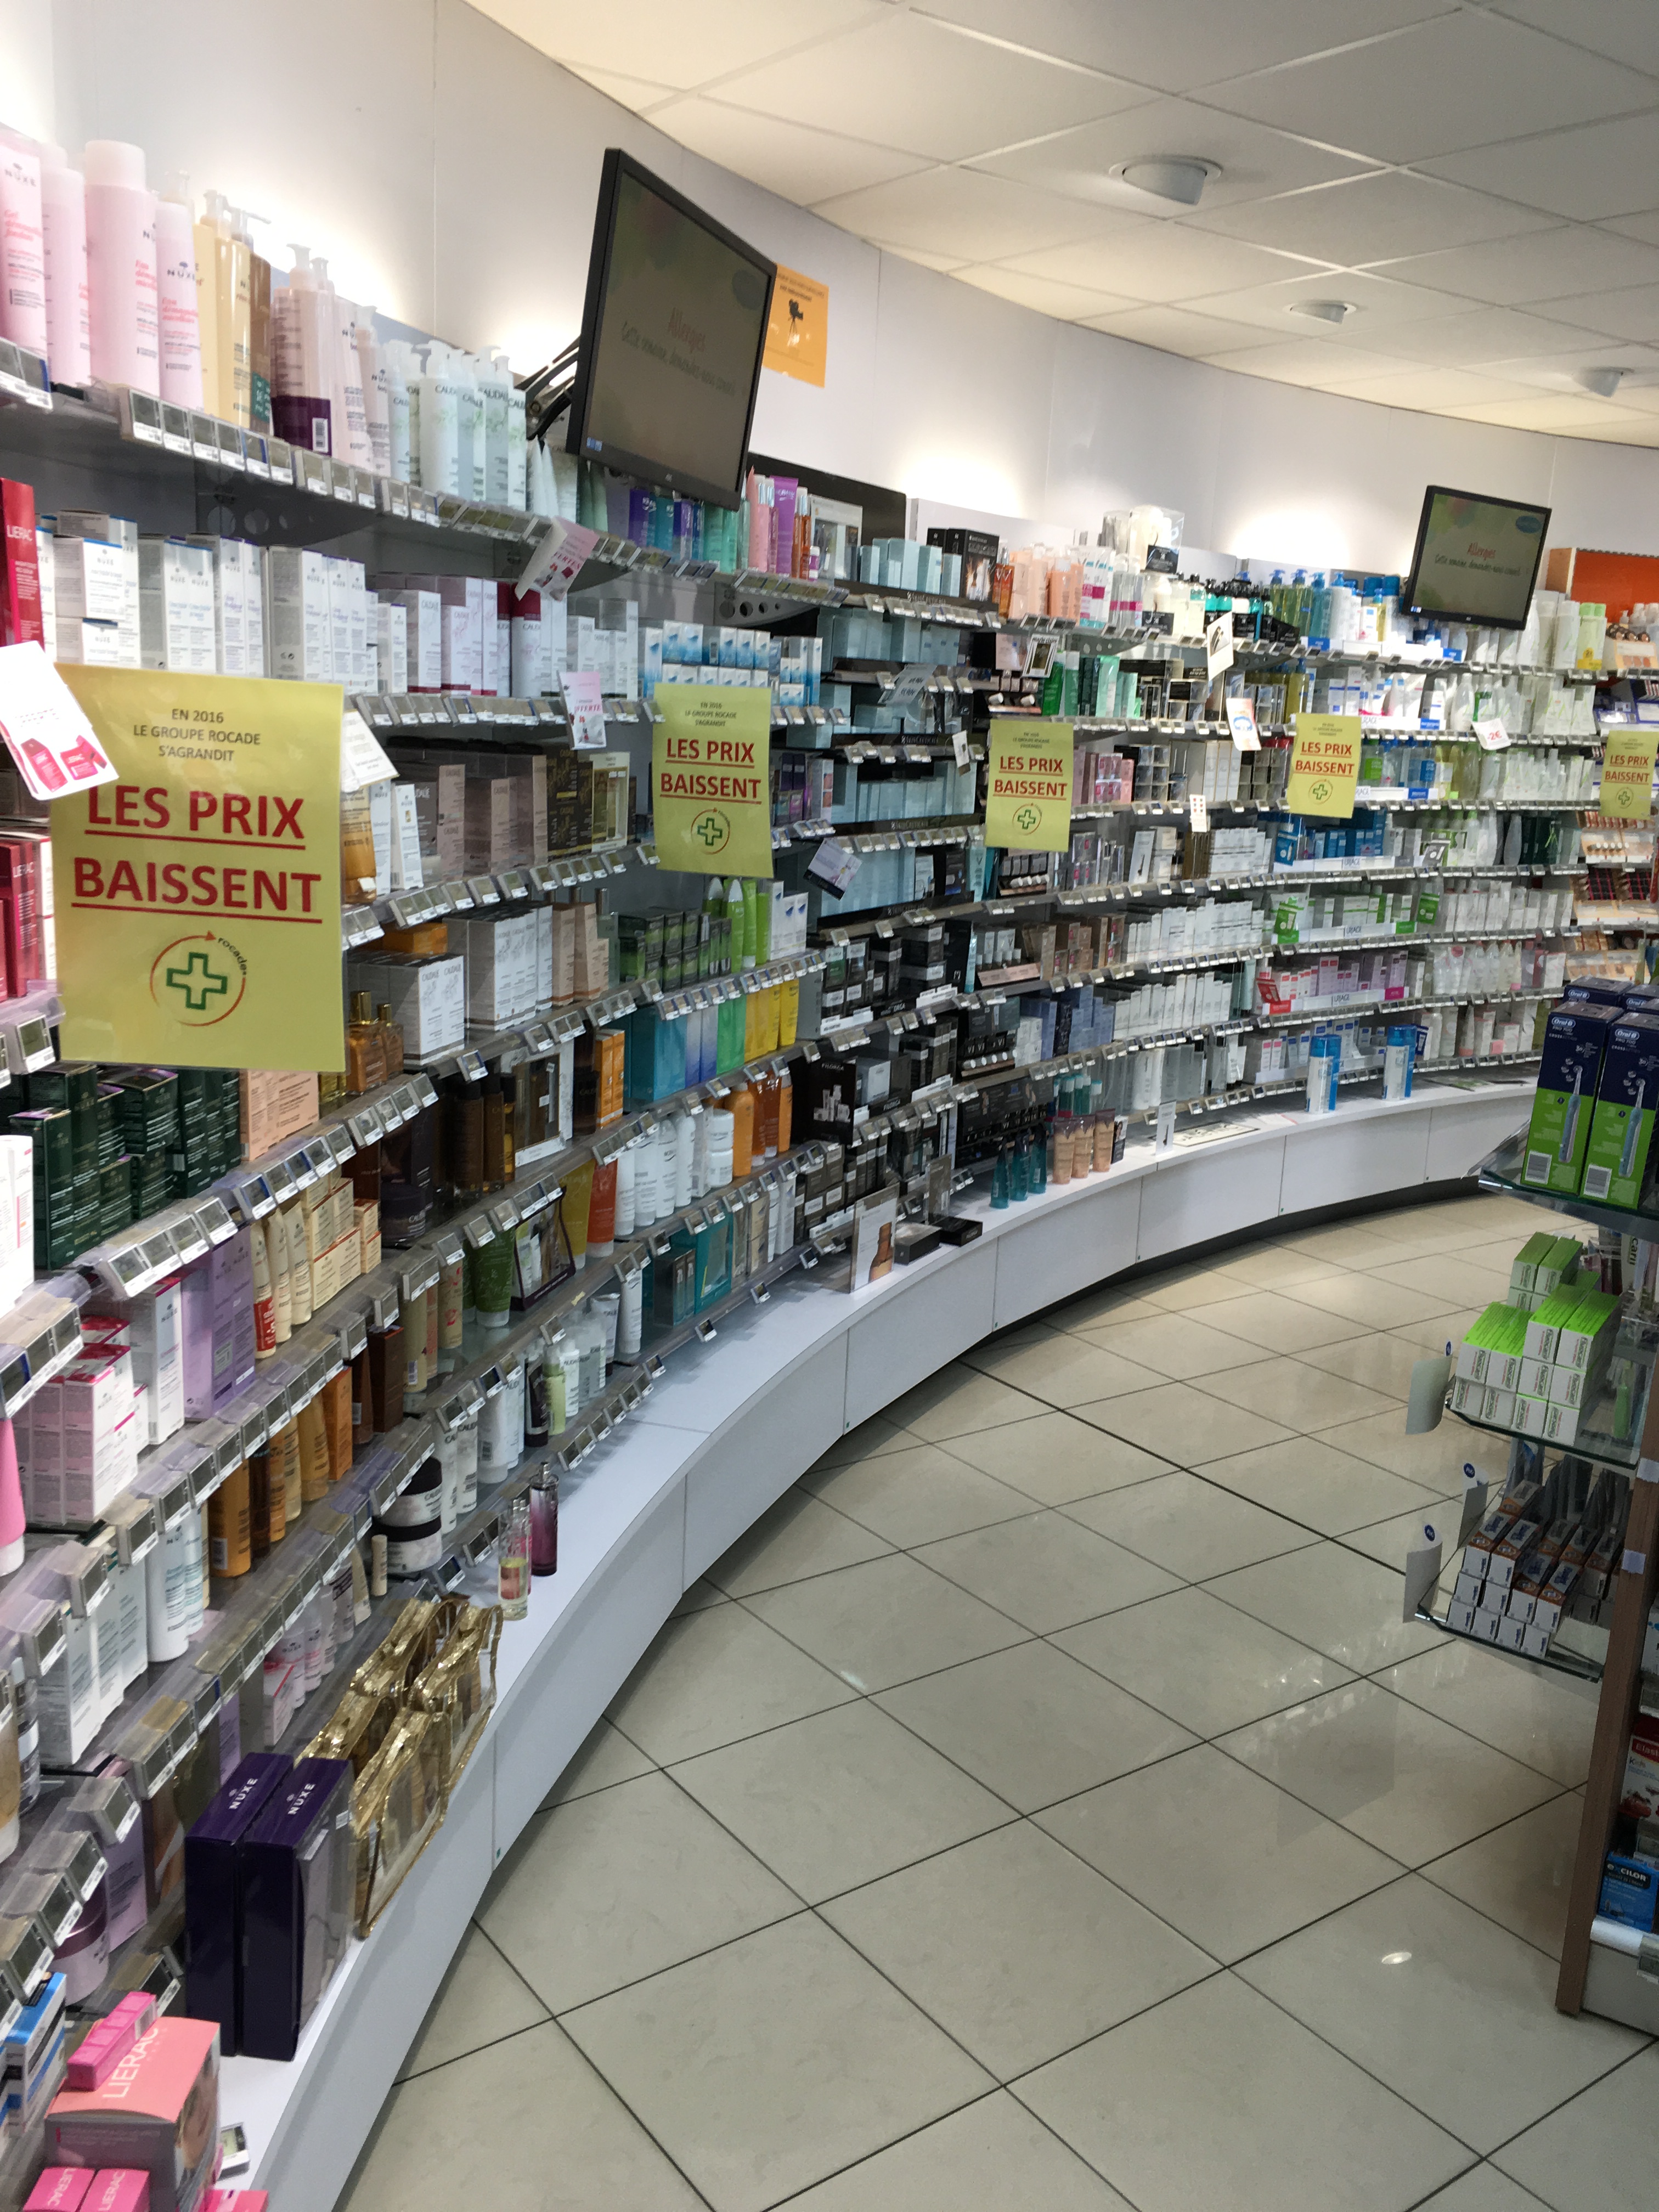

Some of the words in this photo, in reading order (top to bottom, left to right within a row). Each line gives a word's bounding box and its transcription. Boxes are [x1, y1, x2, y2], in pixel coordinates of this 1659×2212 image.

[171, 708, 189, 721] EN
[193, 709, 224, 724] 2016
[133, 724, 148, 737] LE
[151, 726, 205, 741] GROUPE
[208, 730, 261, 745] ROCADE
[667, 737, 699, 760] LES
[706, 740, 754, 764] PRIX
[1301, 741, 1321, 754] LES
[1324, 743, 1353, 756] PRIX
[999, 755, 1024, 771] LES
[1029, 757, 1063, 773] PRIX
[1295, 759, 1355, 775] BAISSENT
[1610, 754, 1626, 765] LES
[1627, 755, 1649, 767] PRIX
[661, 772, 761, 799] BAISSENT
[1605, 770, 1650, 783] BAISSENT
[994, 778, 1068, 797] BAISSENT
[88, 786, 171, 830] LES
[189, 791, 305, 840] PRIX
[74, 856, 322, 912] BAISSENT
[229, 1778, 258, 1810] NUXE
[287, 1782, 316, 1815] NUXE
[102, 2027, 159, 2099] LIERAC
